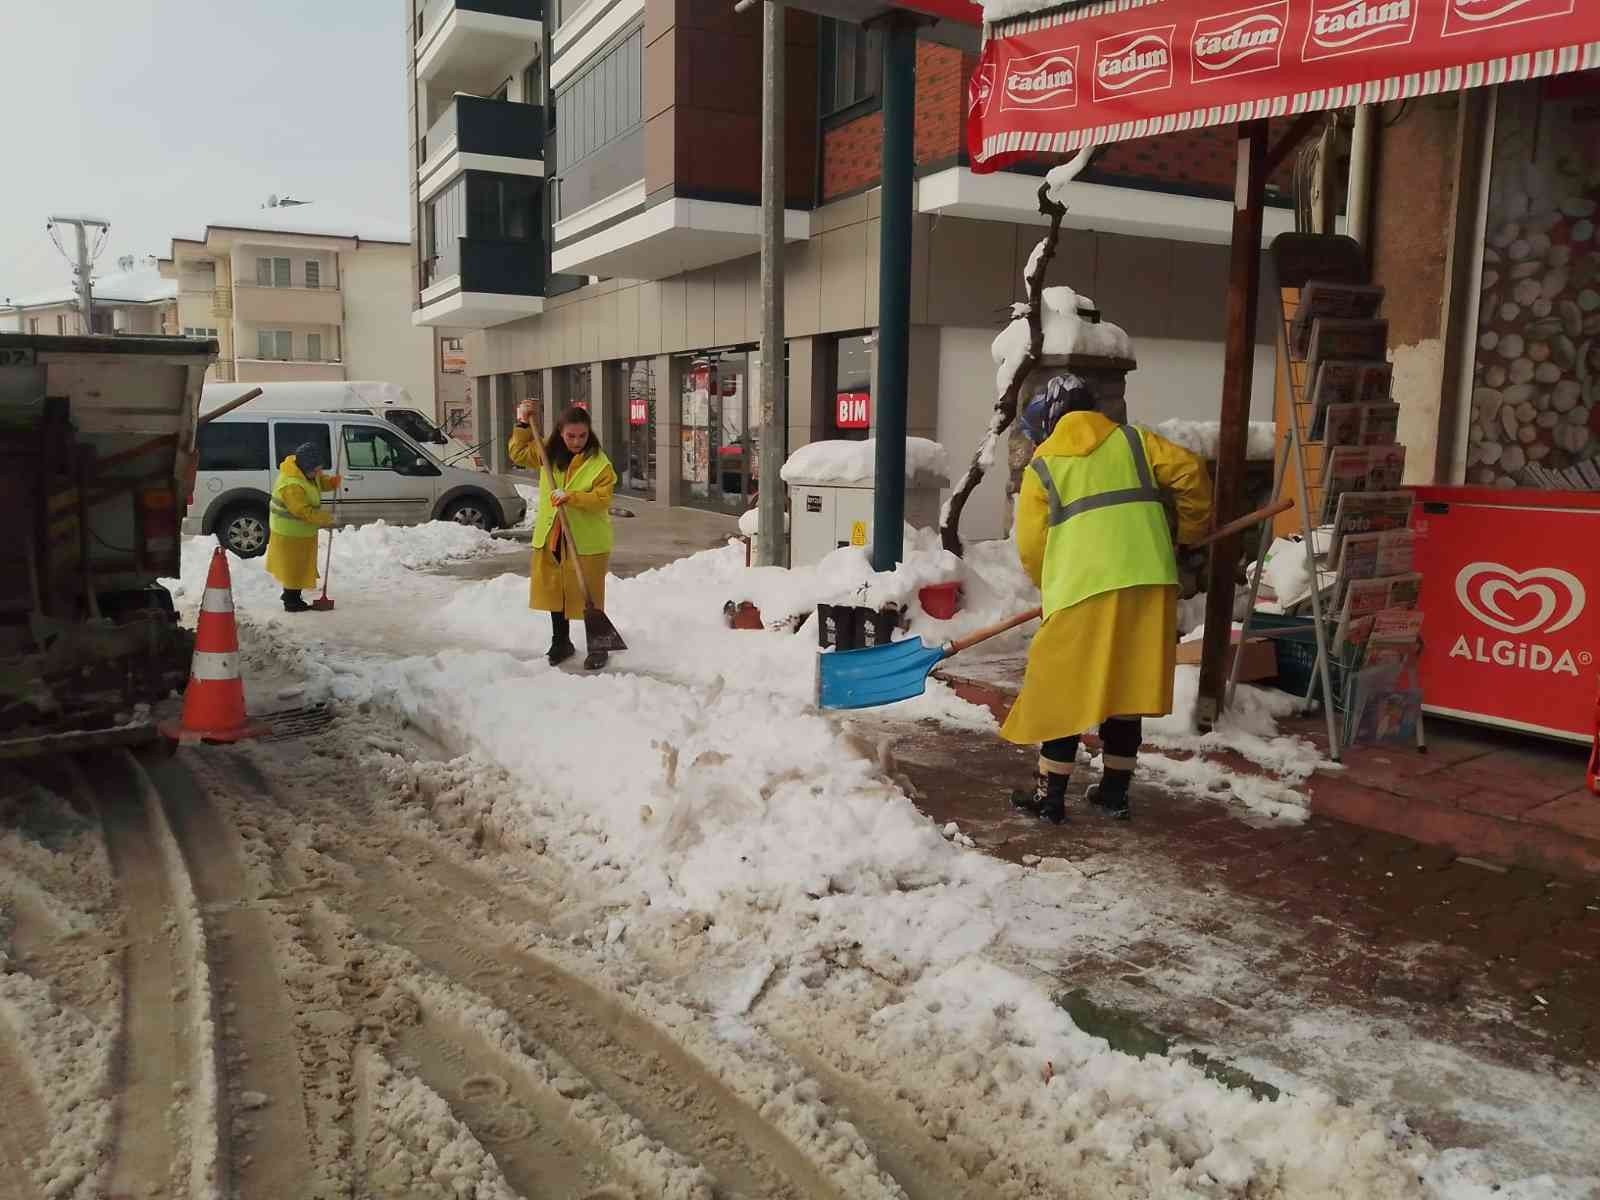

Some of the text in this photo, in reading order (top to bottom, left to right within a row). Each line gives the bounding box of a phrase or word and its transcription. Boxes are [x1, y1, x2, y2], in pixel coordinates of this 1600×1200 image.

[1314, 0, 1411, 35] tadım
[1195, 27, 1280, 57] tadım
[1097, 48, 1168, 78] tadım
[1006, 67, 1073, 92] tadım
